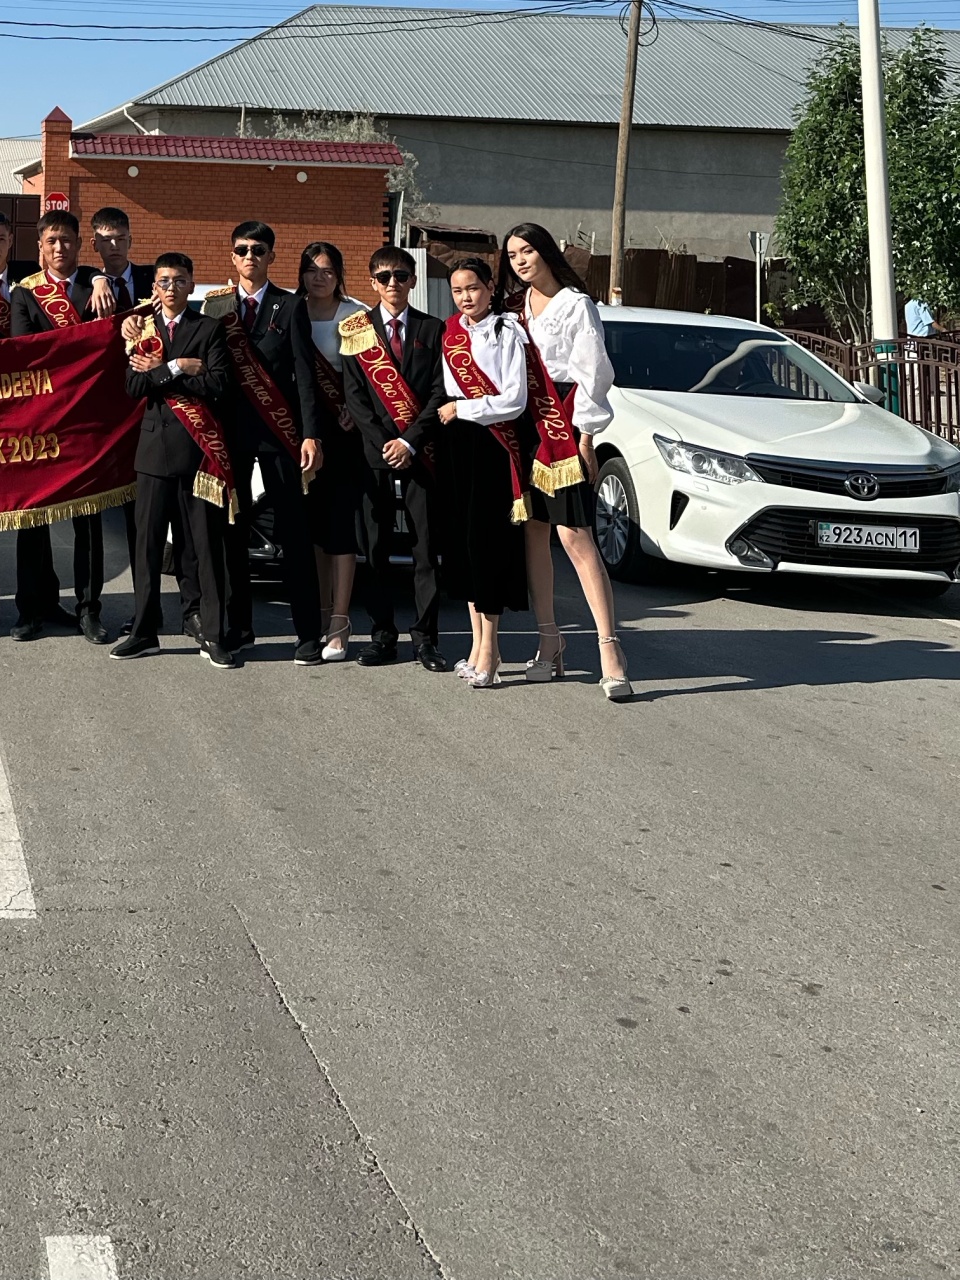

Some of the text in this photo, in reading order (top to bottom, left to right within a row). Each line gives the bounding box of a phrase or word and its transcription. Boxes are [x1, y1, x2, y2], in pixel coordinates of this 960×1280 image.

[45, 200, 69, 210] STOP
[533, 396, 570, 442] 2023
[200, 430, 231, 471] 2023
[898, 530, 918, 548] 11
